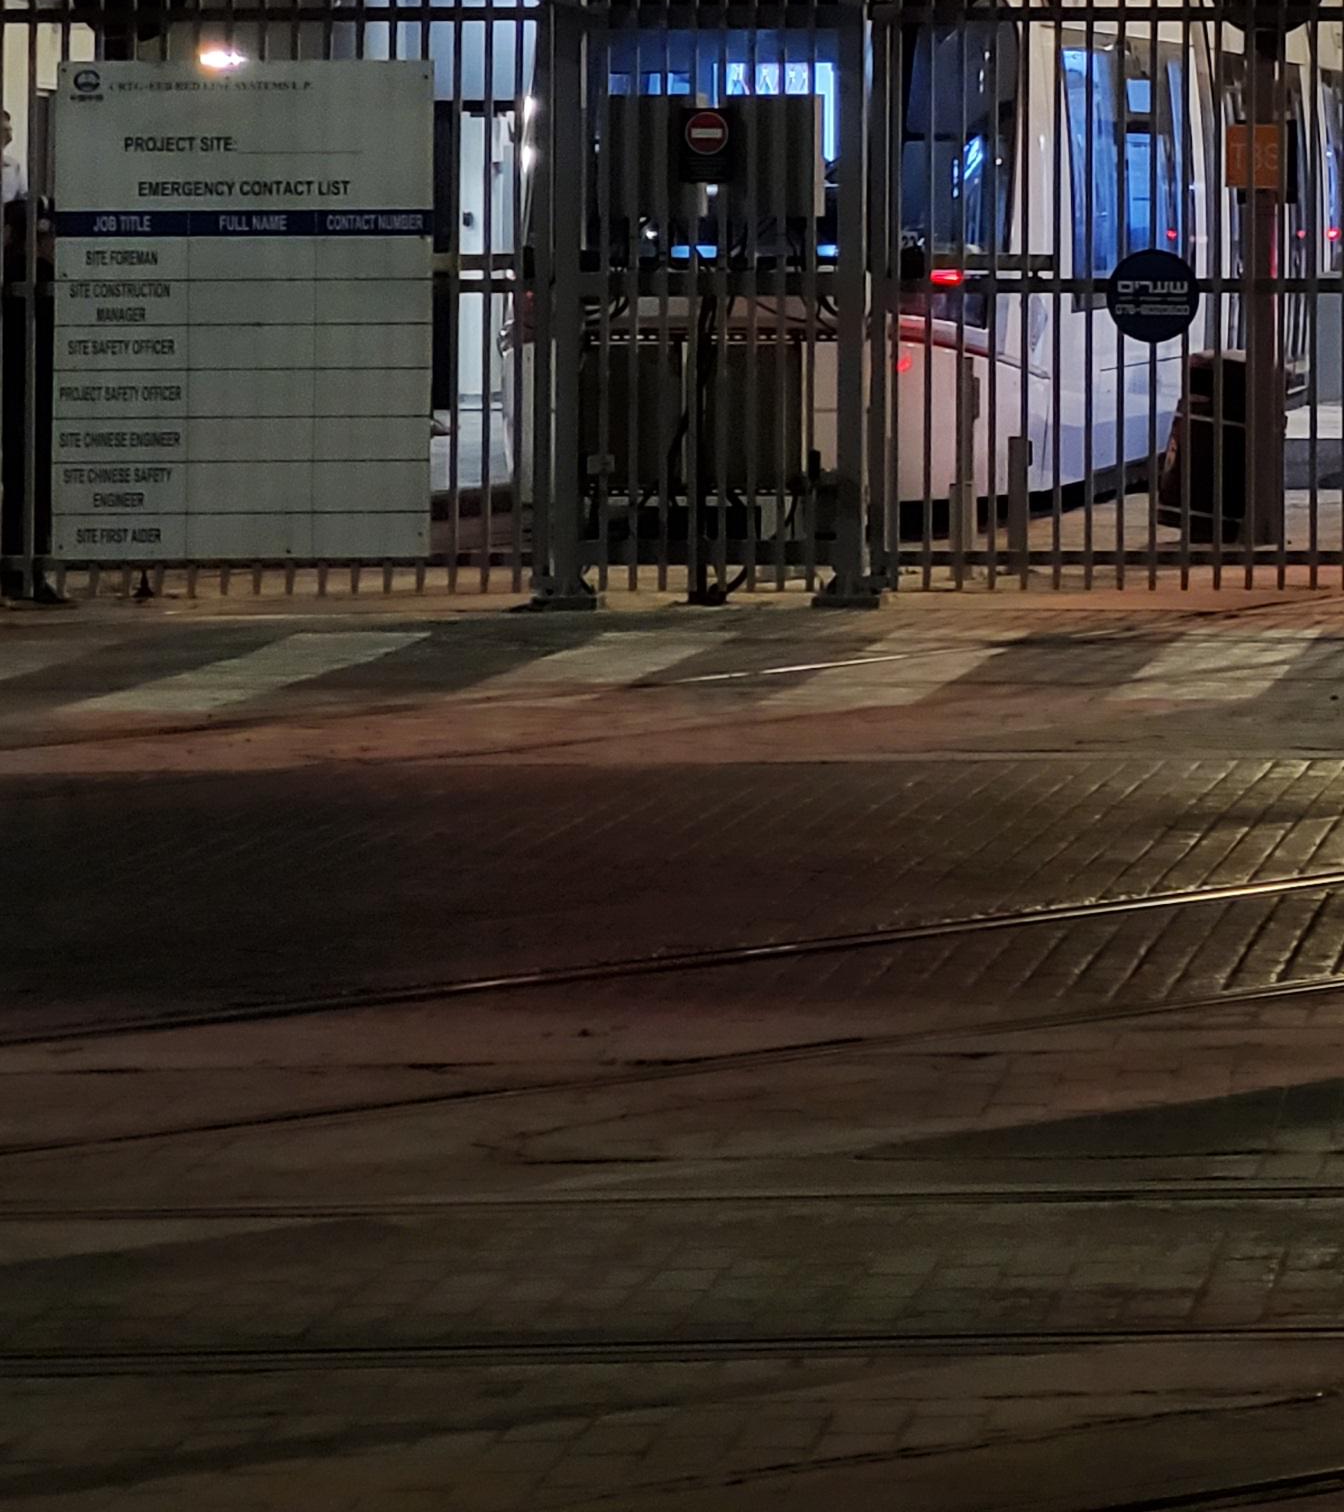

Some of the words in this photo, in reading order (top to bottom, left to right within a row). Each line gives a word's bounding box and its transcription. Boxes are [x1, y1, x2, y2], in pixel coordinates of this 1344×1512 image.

[124, 137, 194, 152] PROJECT
[199, 136, 237, 152] SITE:
[138, 181, 236, 197] EMERGENCY
[239, 180, 314, 196] CONTACT
[317, 180, 350, 195] LIST
[93, 215, 117, 232] JOB
[119, 215, 151, 232] TITLE
[219, 215, 250, 231] FULL
[252, 215, 287, 231] NAME
[326, 215, 376, 230] CONTACT
[377, 215, 424, 230] NUMBER
[86, 250, 108, 265] SITE
[110, 250, 158, 265] FOREMAN
[69, 284, 91, 298] SITE
[92, 284, 171, 298] CONSTRUCTION
[1117, 280, 1188, 293] שערים
[96, 307, 146, 322] MANAGER
[68, 340, 90, 355] SITE
[91, 340, 131, 355] SAFETY
[132, 339, 176, 355] OFFICER
[59, 386, 103, 402] PROJECT
[104, 386, 140, 401] SAFETY
[142, 385, 182, 401] OFFICER
[59, 432, 81, 448] SITE
[83, 432, 128, 448] CHINESE
[129, 432, 181, 447] ENGINEER
[64, 468, 85, 484] SITE
[87, 468, 131, 484] CHINESE
[134, 467, 173, 483] SAFETY
[93, 492, 144, 507] ENGINEER
[76, 528, 98, 543] SITE
[100, 528, 129, 543] FIRST
[131, 528, 161, 543] AIDER
